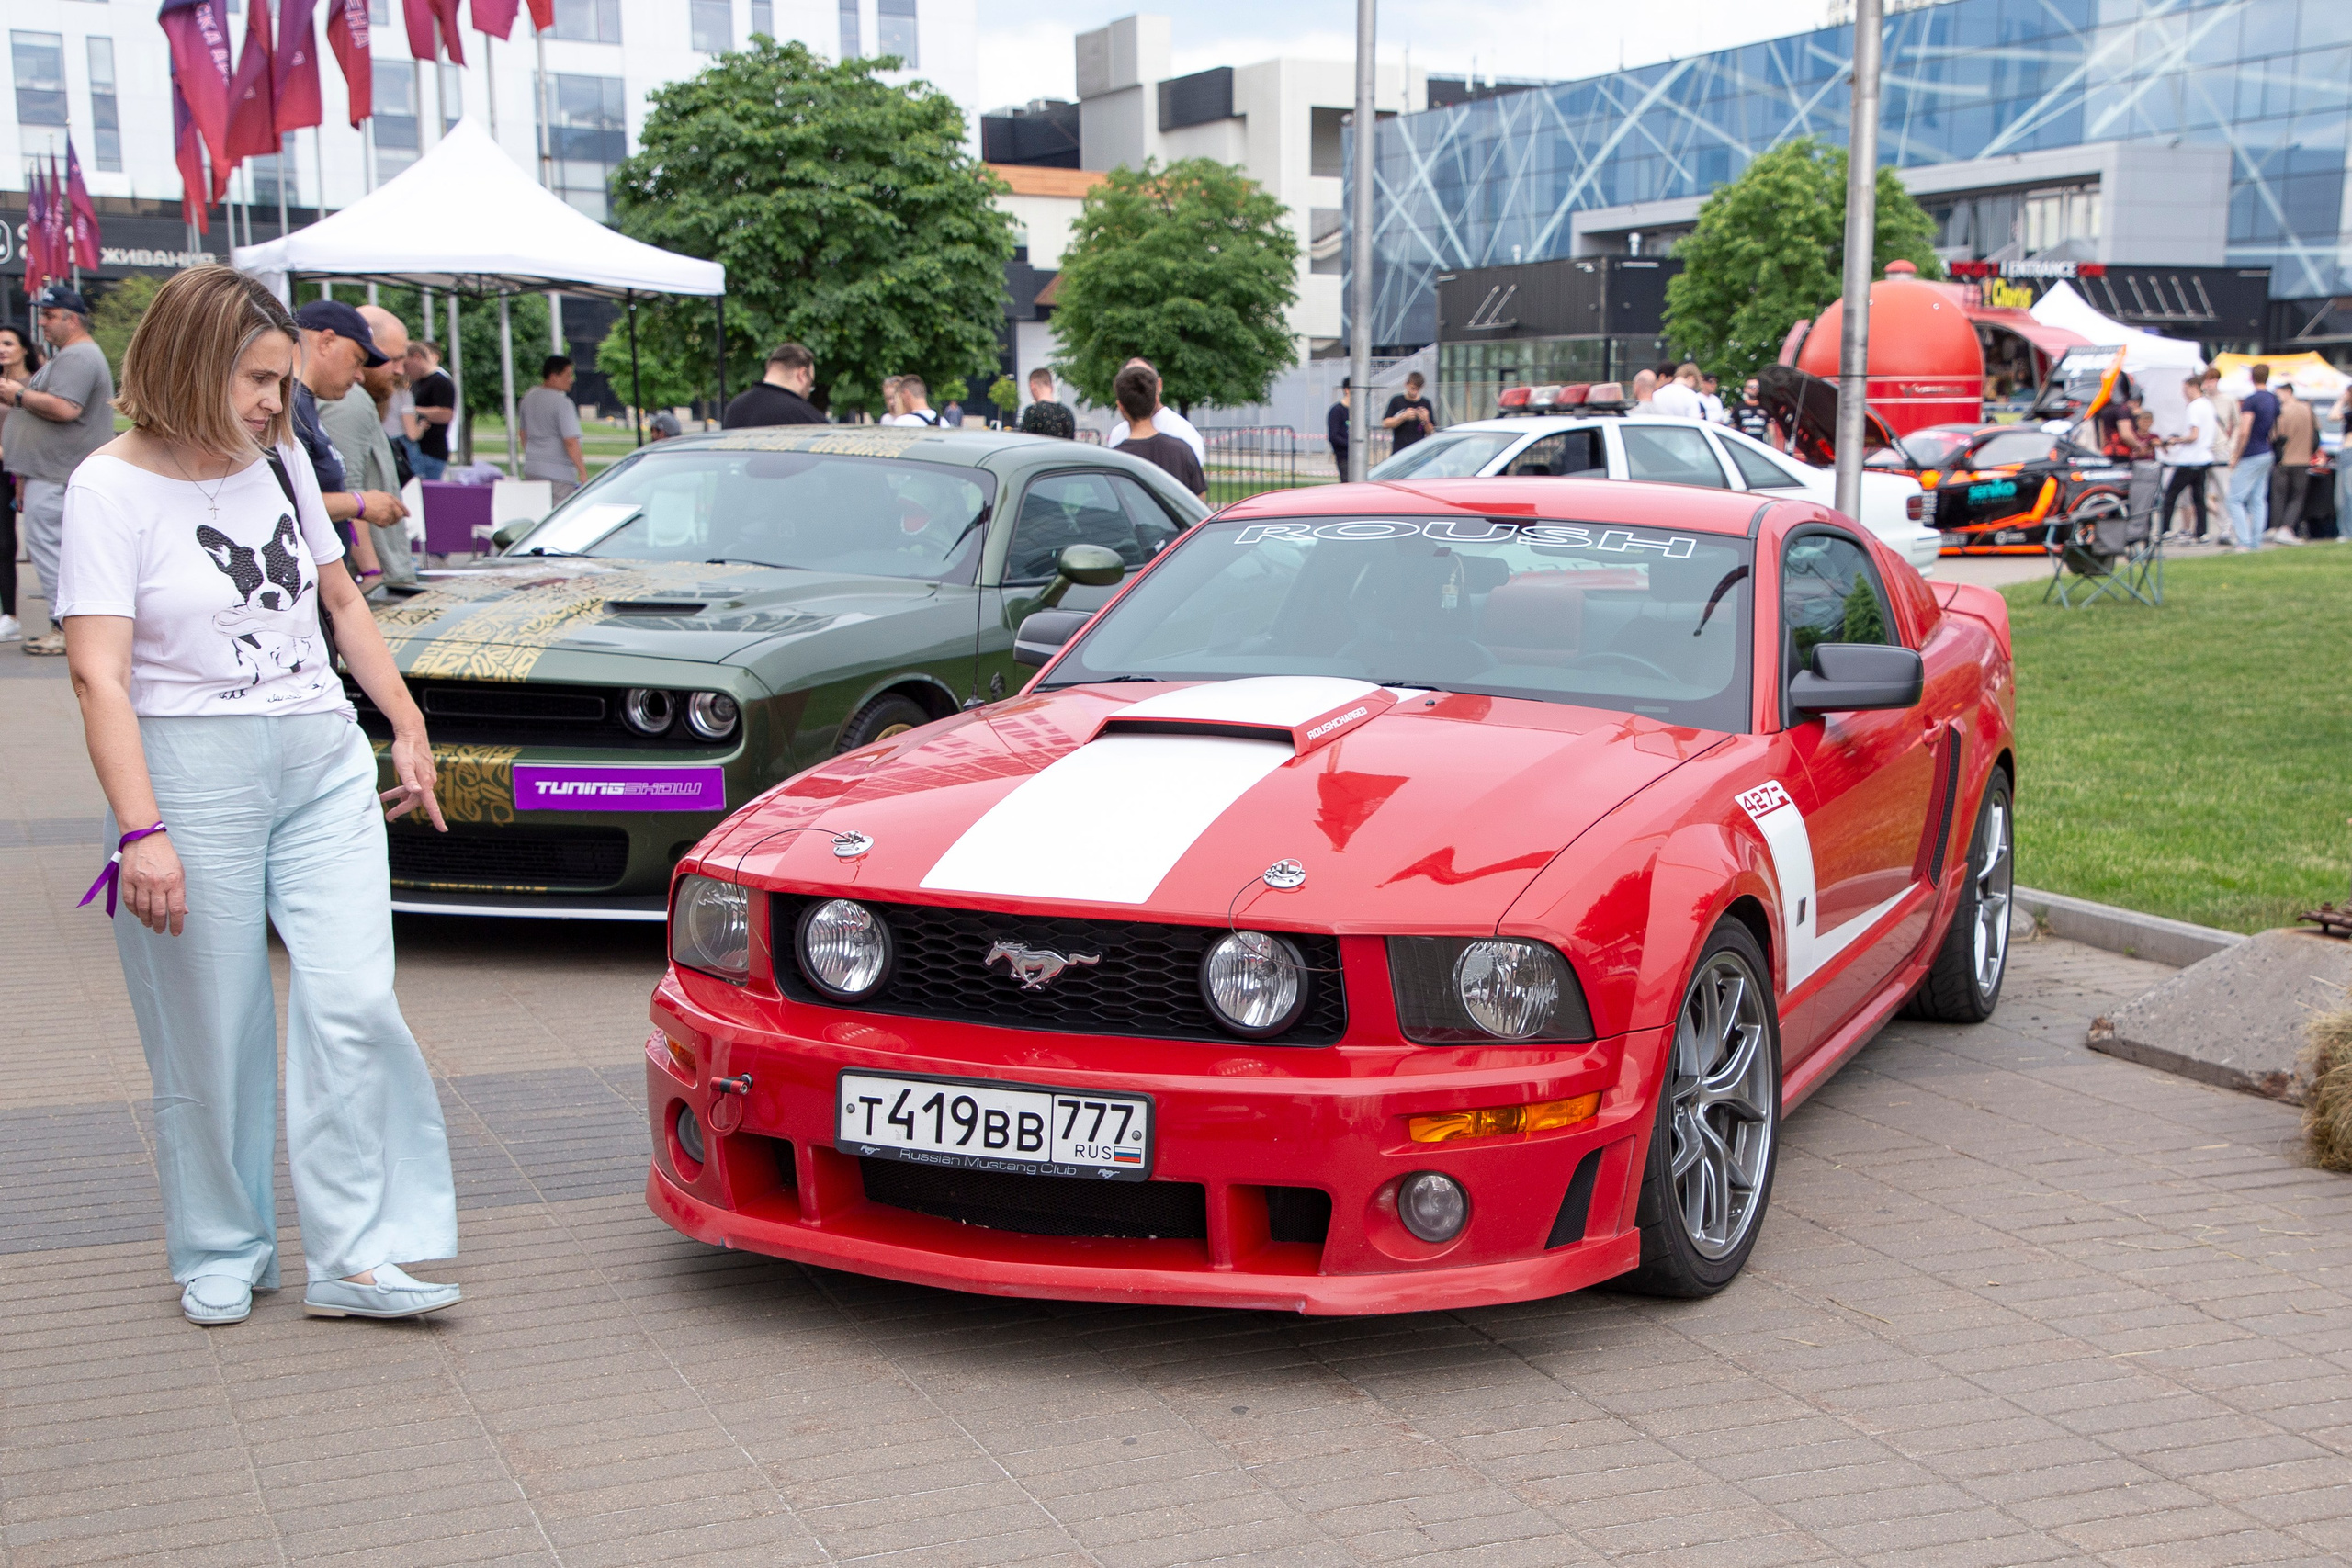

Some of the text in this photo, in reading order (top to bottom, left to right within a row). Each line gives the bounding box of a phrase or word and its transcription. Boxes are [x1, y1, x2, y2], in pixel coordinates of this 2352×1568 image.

[195, 2, 223, 46] СКА
[1234, 520, 1698, 559] ROUSH
[1306, 705, 1368, 741] ROUSHCHARGED
[1057, 1099, 1135, 1145] 777
[899, 1147, 1077, 1177] Russian Mustang Club
[1074, 1144, 1113, 1160] RUS
